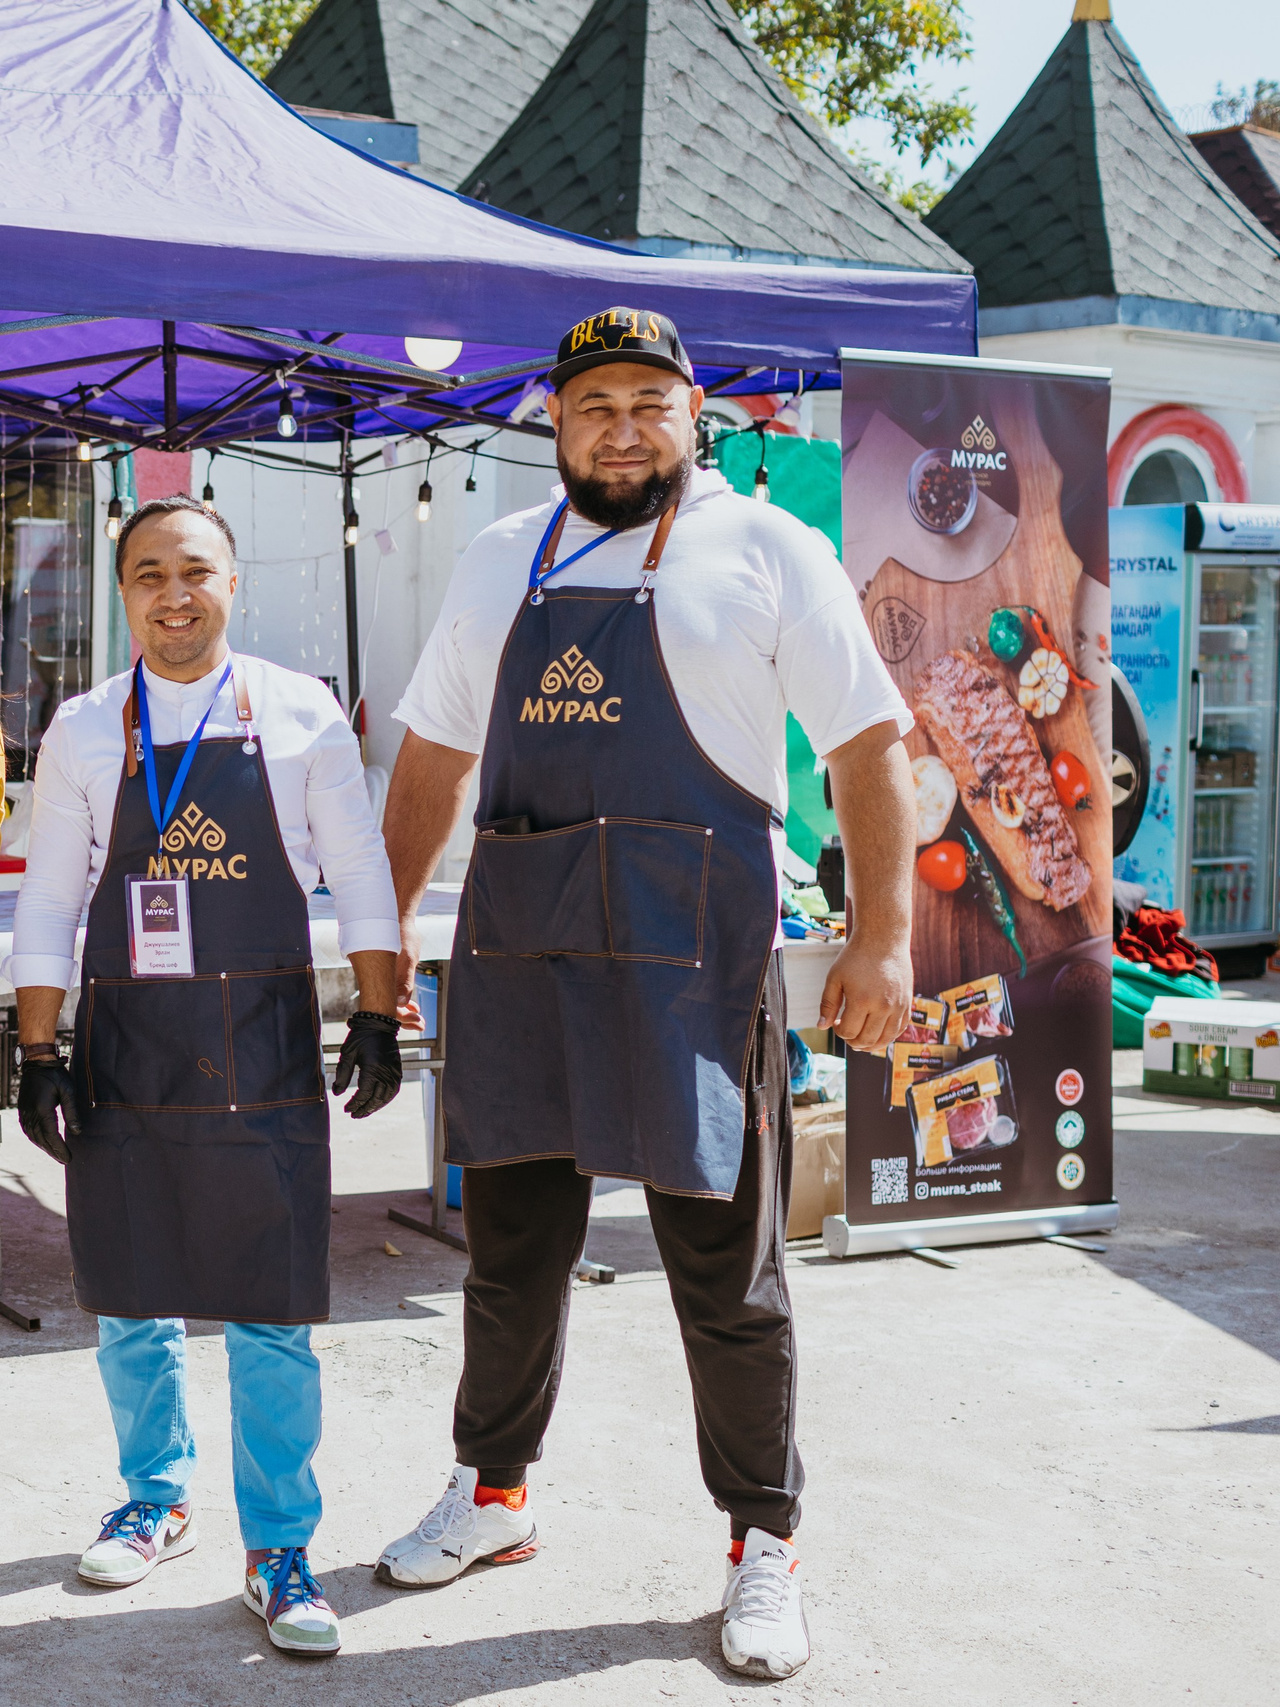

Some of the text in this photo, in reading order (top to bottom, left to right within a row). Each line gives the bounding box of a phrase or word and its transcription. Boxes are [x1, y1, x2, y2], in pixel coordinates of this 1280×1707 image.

[950, 449, 1007, 471] МУРАС
[519, 696, 622, 723] МУРАС
[147, 853, 247, 880] МУРАС
[145, 908, 175, 916] МУРАС
[915, 1162, 1002, 1177] Больше информации:
[930, 1179, 1002, 1197] muras_steak
